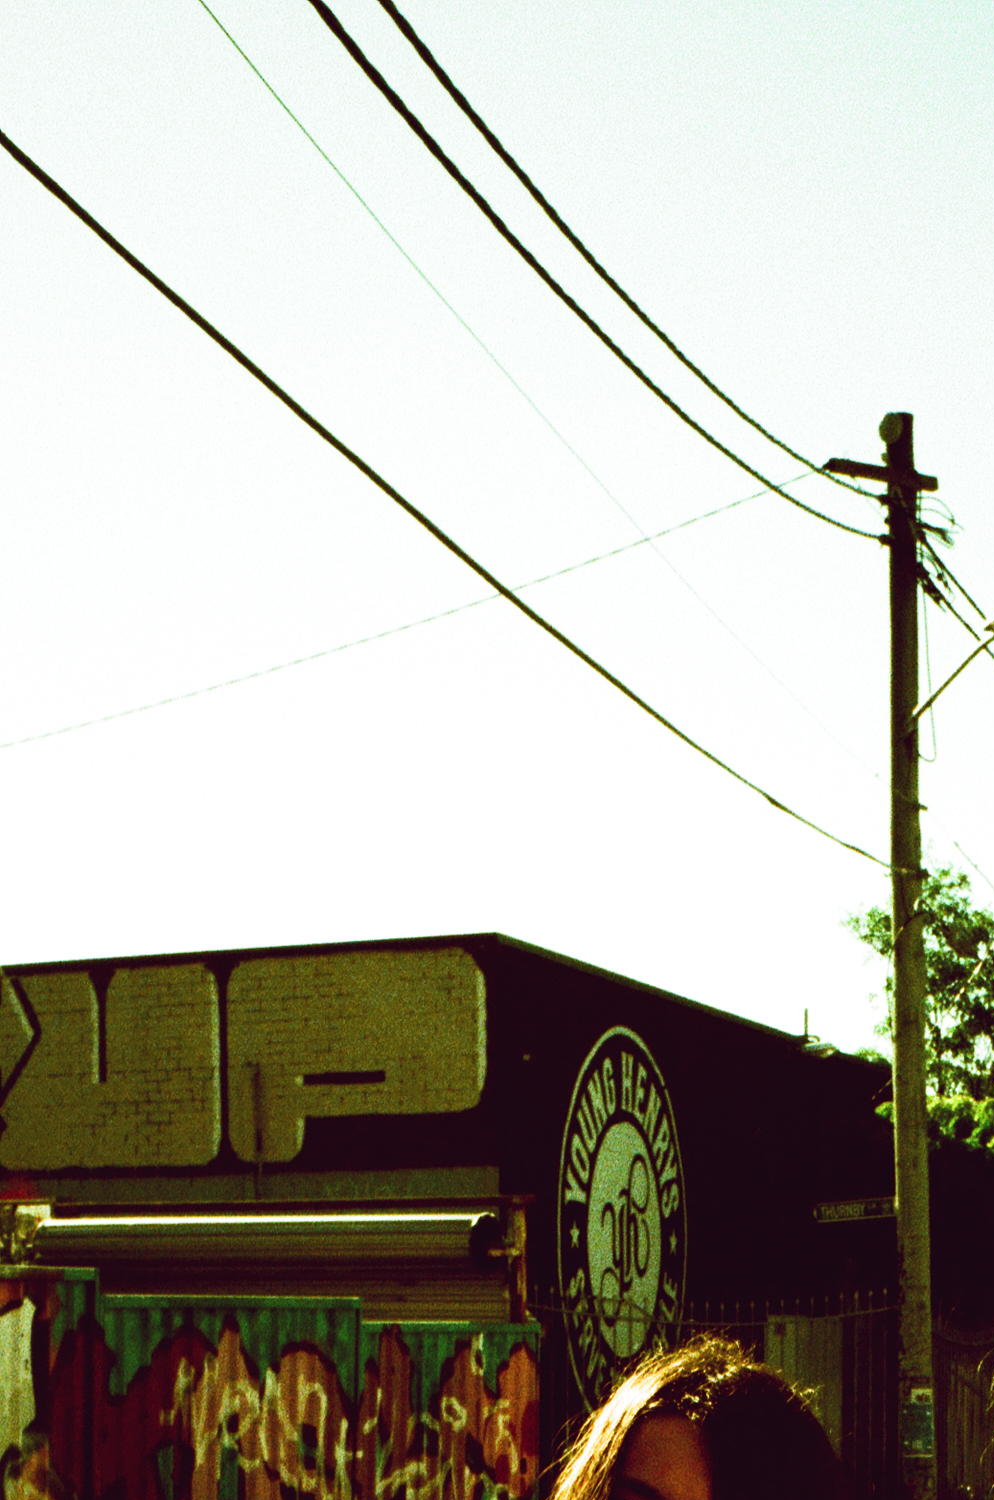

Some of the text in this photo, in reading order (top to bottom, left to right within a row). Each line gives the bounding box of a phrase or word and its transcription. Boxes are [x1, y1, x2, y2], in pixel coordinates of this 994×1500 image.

[564, 1050, 681, 1219] YOUNG HENRYS
[819, 1202, 866, 1220] THURNBY
